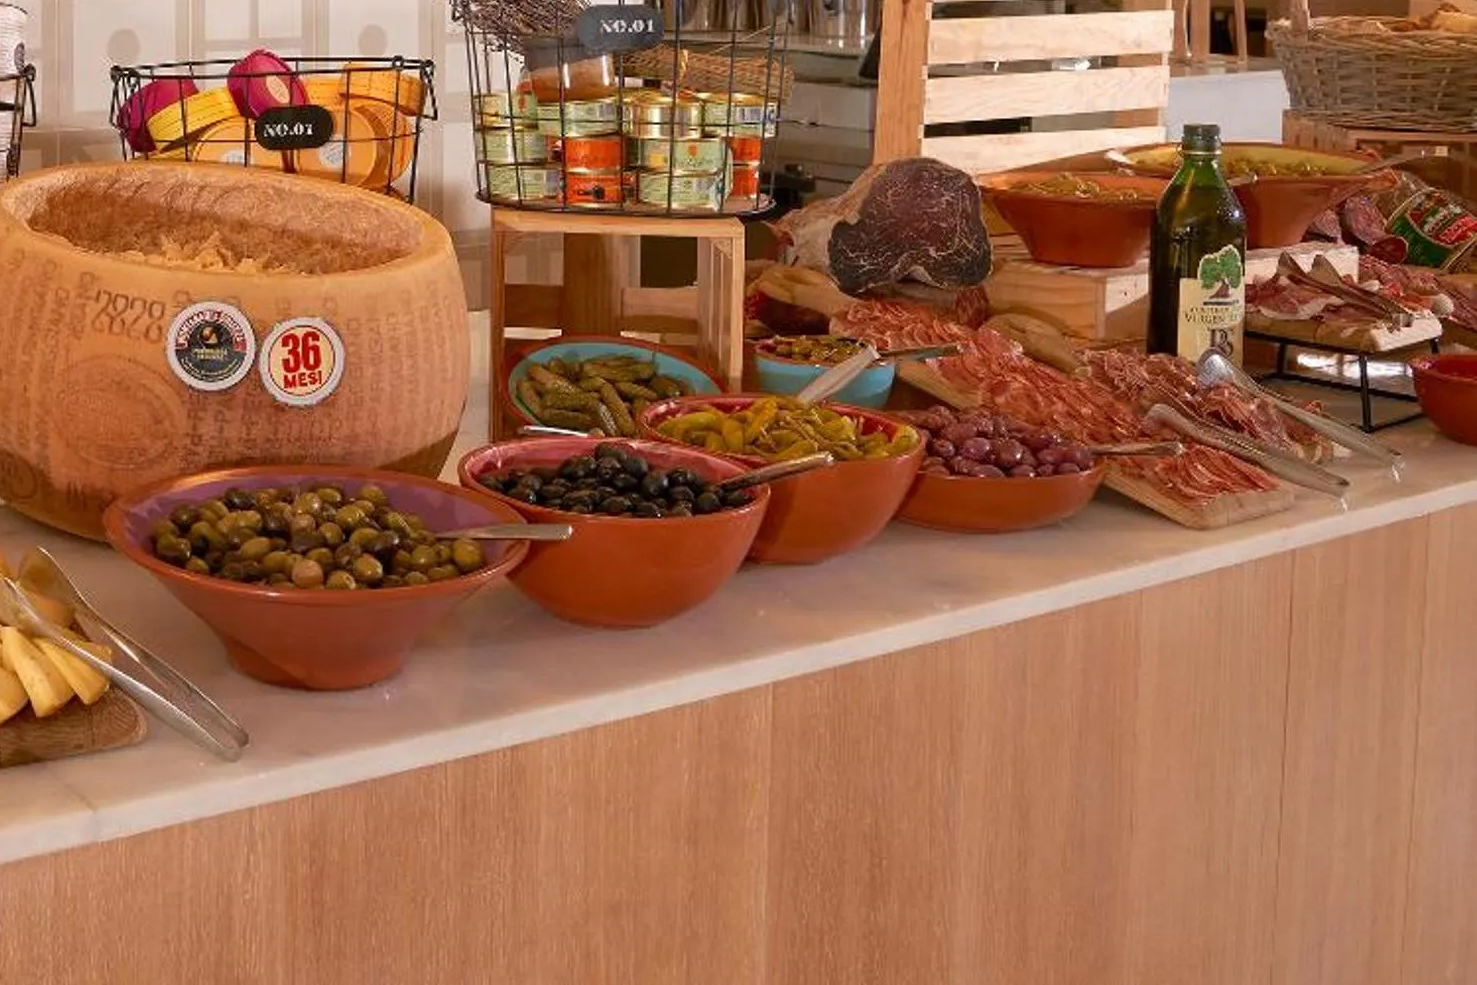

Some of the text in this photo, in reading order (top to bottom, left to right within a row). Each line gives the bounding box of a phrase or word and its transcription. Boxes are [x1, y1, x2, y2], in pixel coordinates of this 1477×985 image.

[600, 18, 655, 33] NO.01
[264, 122, 313, 137] NO.01
[281, 330, 322, 375] 36
[283, 368, 323, 390] MESI
